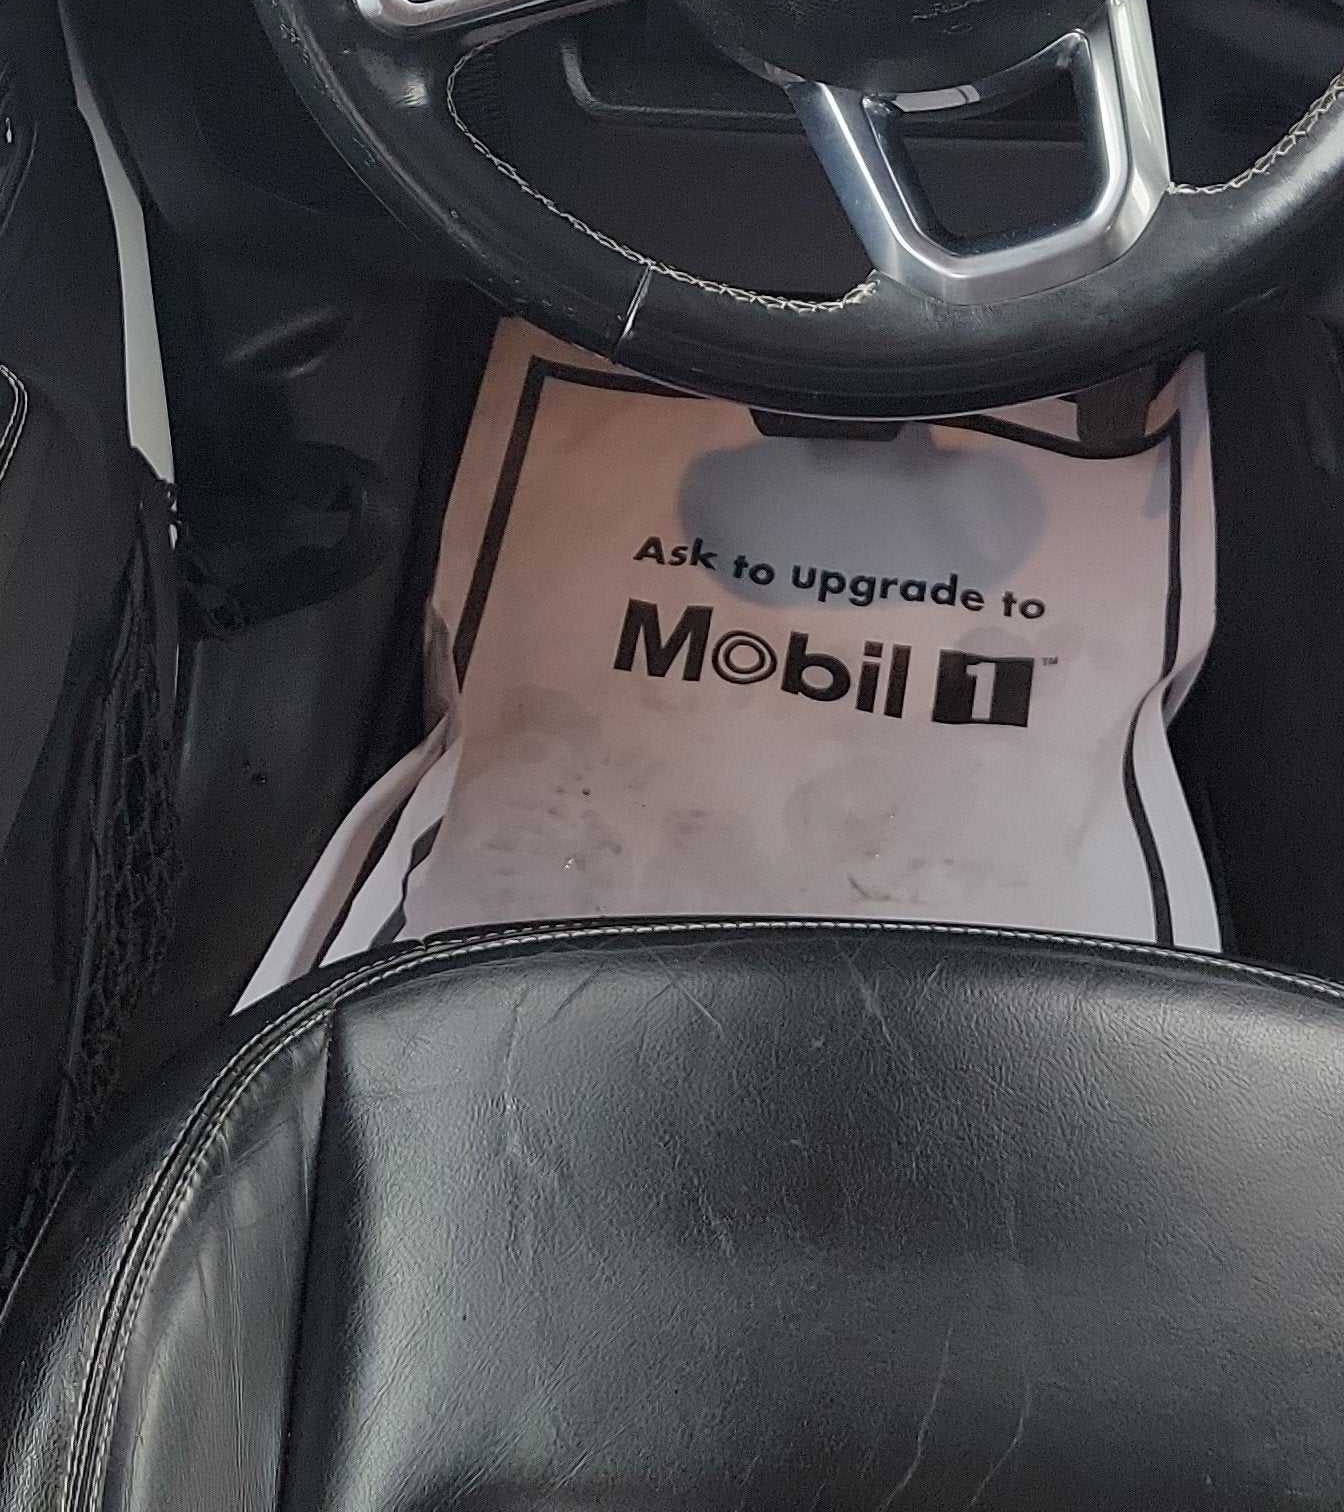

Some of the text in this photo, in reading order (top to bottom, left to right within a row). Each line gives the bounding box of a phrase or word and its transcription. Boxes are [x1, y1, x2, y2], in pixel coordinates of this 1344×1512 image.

[632, 535, 1047, 620] Ask to upgrade to
[613, 598, 912, 719] Mobil
